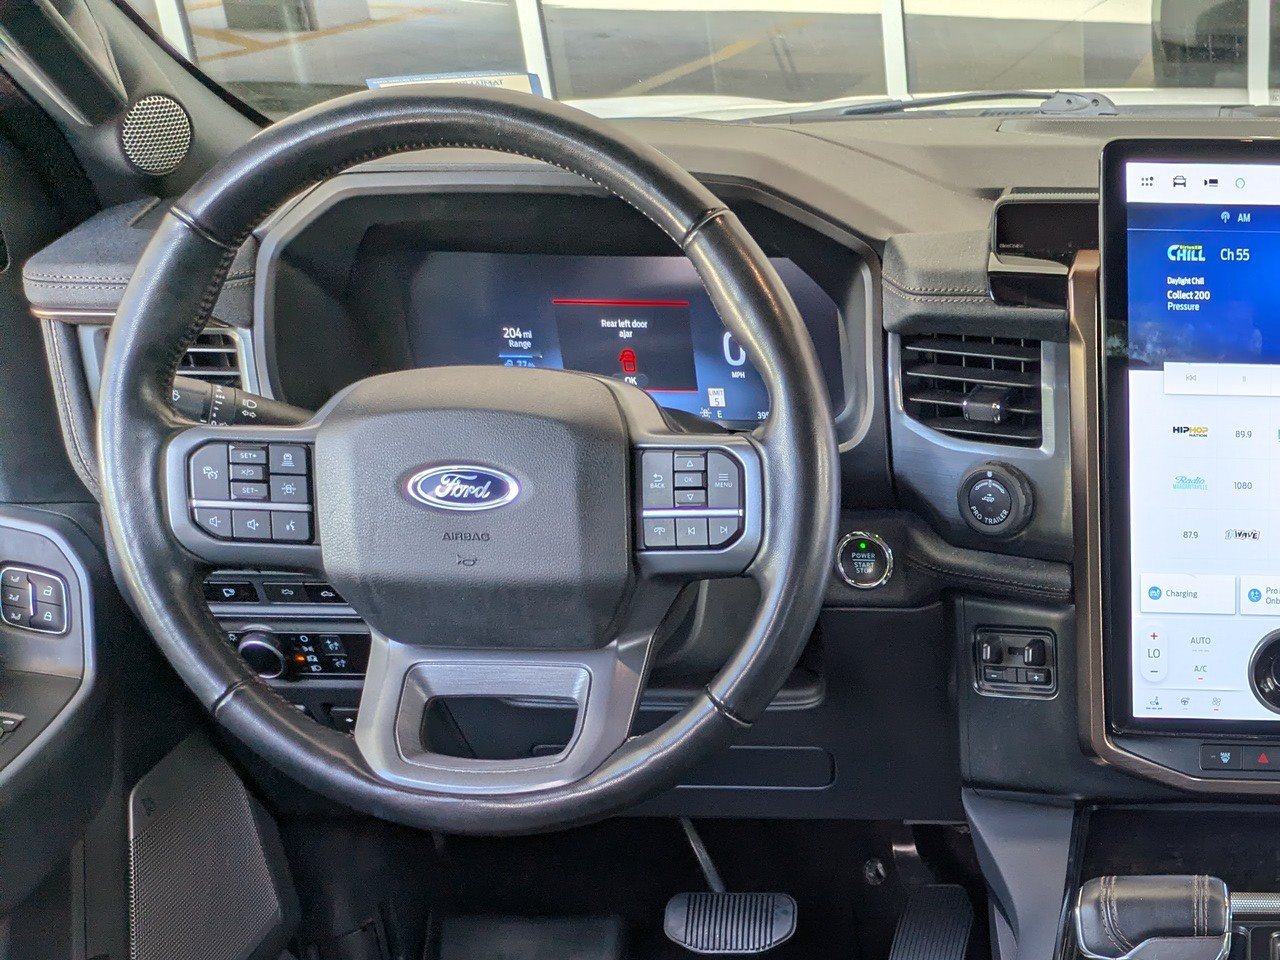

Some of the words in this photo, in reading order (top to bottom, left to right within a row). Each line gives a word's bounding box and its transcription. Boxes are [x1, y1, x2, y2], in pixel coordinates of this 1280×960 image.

[1237, 213, 1251, 223] AM
[1220, 248, 1234, 261] Ch
[1236, 249, 1250, 261] 55
[1167, 277, 1191, 286] Daylight
[1191, 277, 1205, 285] Chill
[1167, 290, 1193, 300] Collect
[1194, 291, 1211, 300] 200
[1167, 302, 1200, 311] Pressure
[600, 319, 617, 328] Rear
[618, 319, 631, 328] left
[631, 319, 648, 328] door
[502, 327, 523, 339] 204
[523, 330, 533, 339] mi
[619, 329, 633, 339] ajar
[508, 339, 532, 350] Range
[731, 371, 745, 379] MPH
[1235, 430, 1252, 439] 89.9
[435, 473, 492, 499] Ford
[1234, 481, 1253, 490] 1080
[970, 505, 983, 520] PRO
[984, 509, 1009, 524] TRAILER
[442, 532, 490, 541] AIRBAG
[1183, 531, 1199, 539] 87.9
[1165, 589, 1198, 599] Charging
[1265, 587, 1278, 595] Pro
[1190, 636, 1212, 645] AUTO
[1147, 648, 1161, 659] LO
[1193, 665, 1208, 673] A/C
